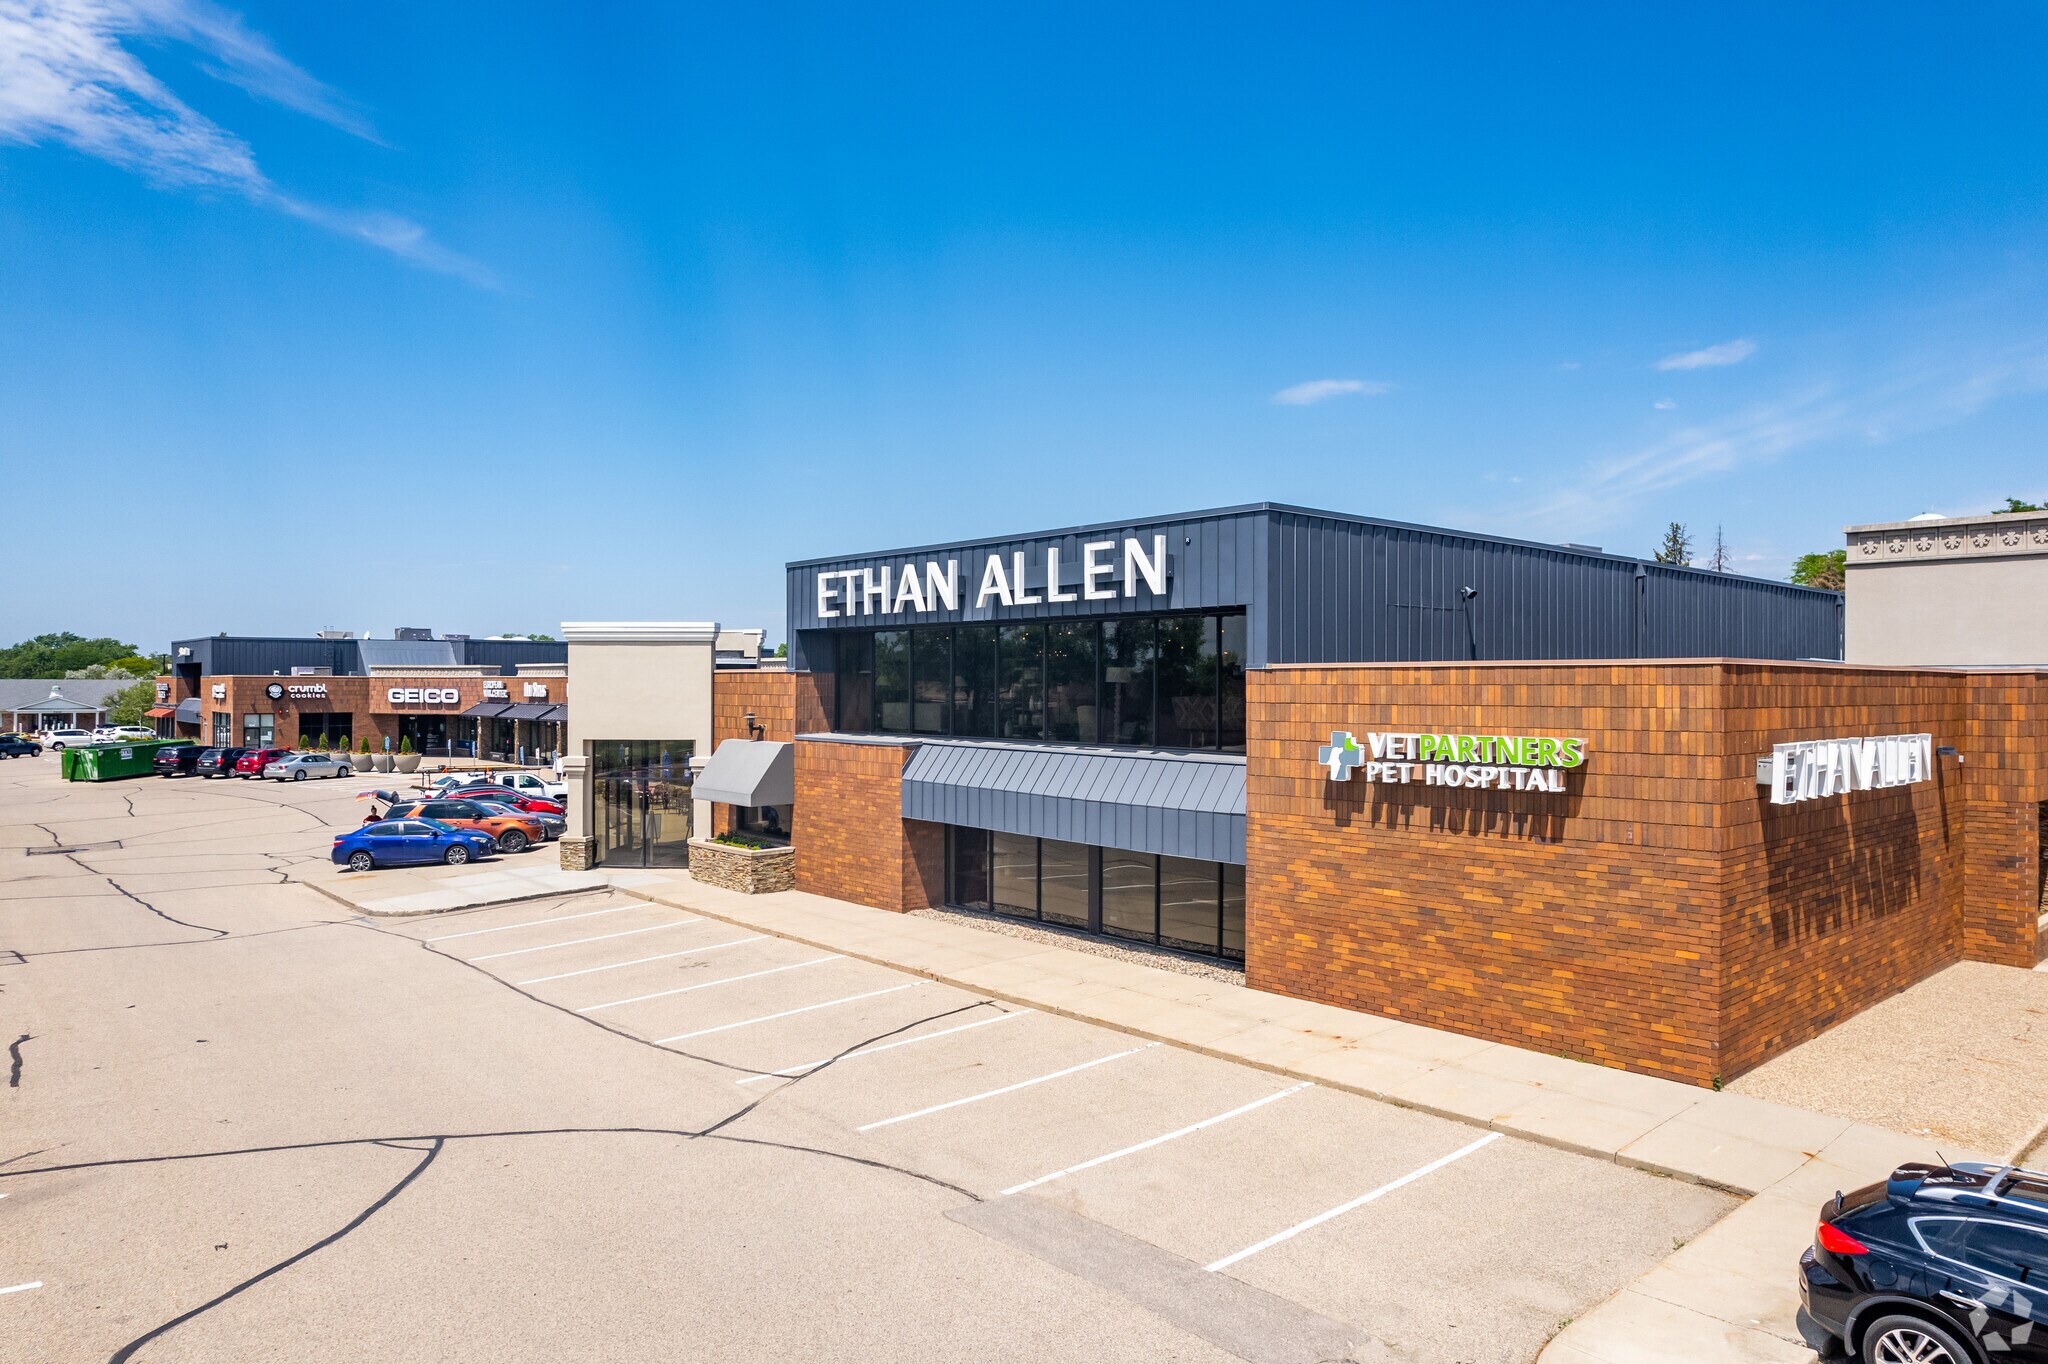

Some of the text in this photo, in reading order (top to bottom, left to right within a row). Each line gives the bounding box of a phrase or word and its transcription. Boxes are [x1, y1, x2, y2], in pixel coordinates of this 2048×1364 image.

[817, 535, 1166, 618] ETHAN ALLEN
[288, 683, 328, 693] crumbl
[388, 688, 460, 704] GEICO
[1367, 732, 1586, 767] VETPARTNERS
[1366, 761, 1566, 792] PET HOSPITAL
